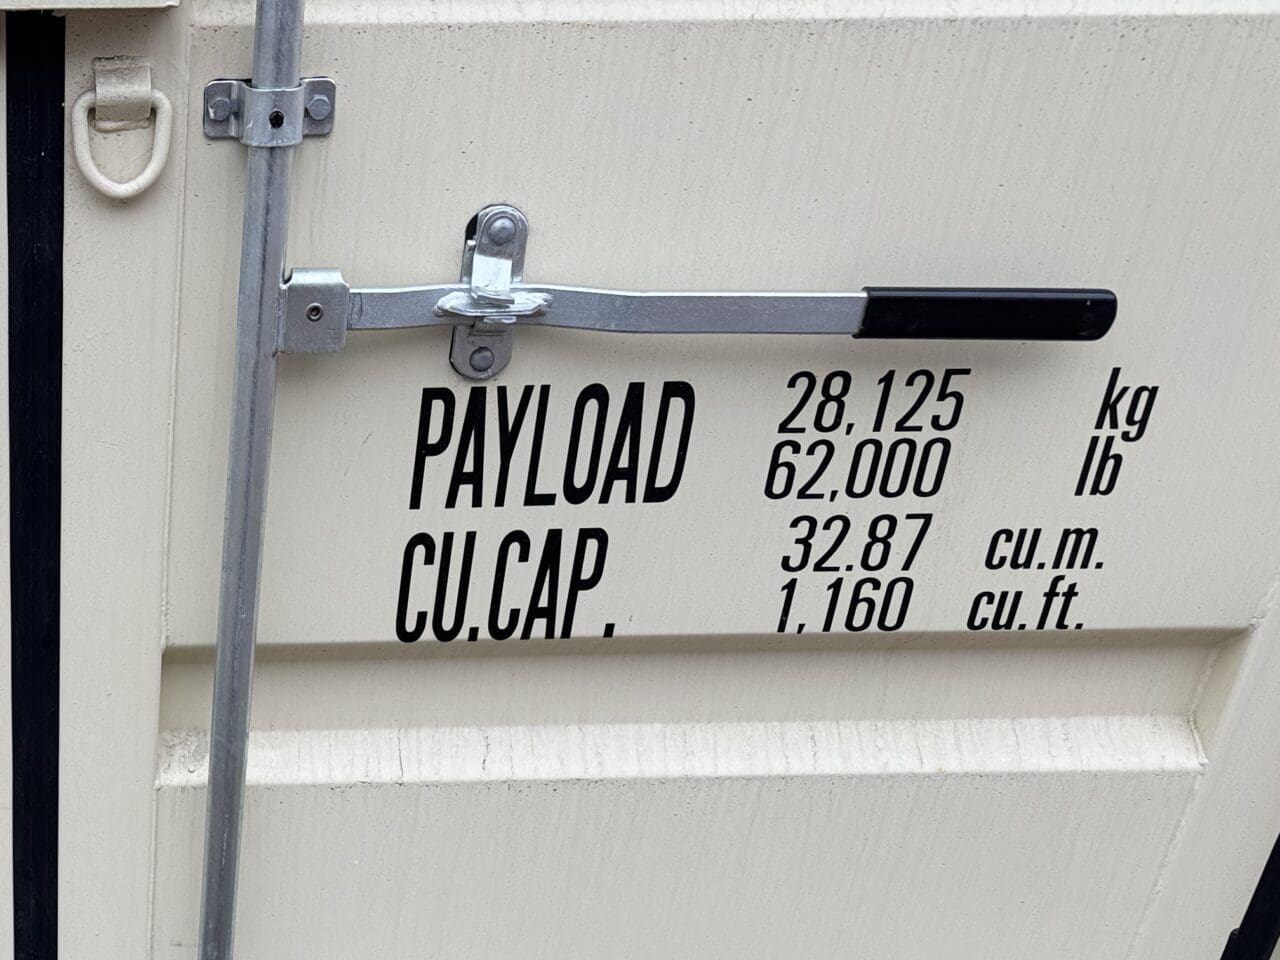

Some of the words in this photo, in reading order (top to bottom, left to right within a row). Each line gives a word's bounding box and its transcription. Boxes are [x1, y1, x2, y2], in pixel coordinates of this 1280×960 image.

[778, 368, 971, 435] 28,125
[1095, 368, 1158, 442] kg
[410, 381, 695, 509] PAYLOAD
[765, 438, 951, 502] 62,000
[1075, 436, 1122, 496] lb
[781, 514, 932, 572] 32.87
[985, 528, 1103, 569] cu.m.
[396, 528, 615, 643] CU.CAP.
[777, 577, 913, 634] 1,160
[967, 575, 1083, 630] cu.ft.
